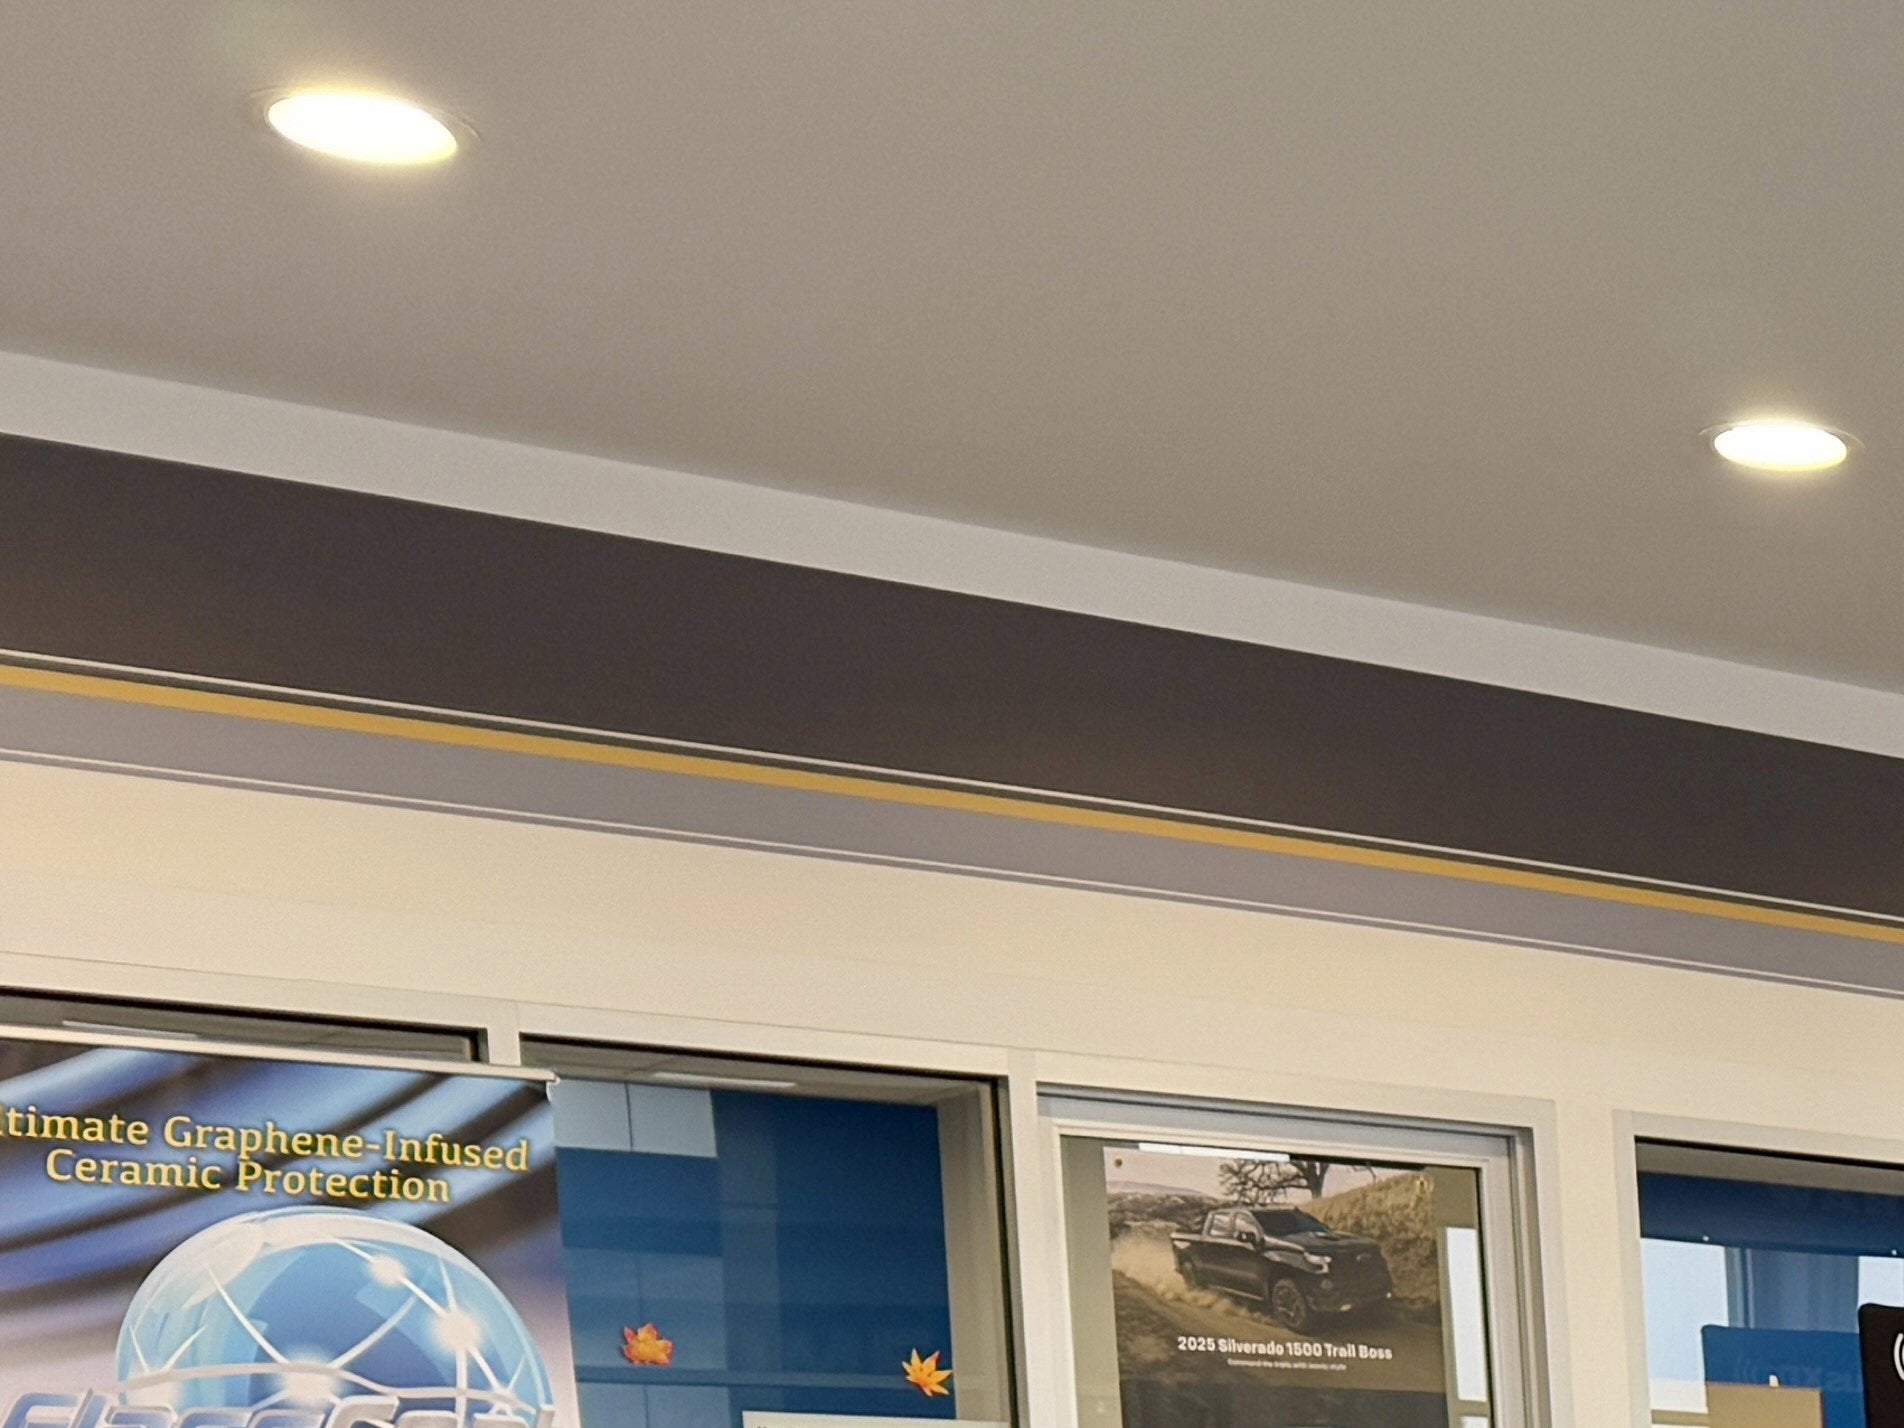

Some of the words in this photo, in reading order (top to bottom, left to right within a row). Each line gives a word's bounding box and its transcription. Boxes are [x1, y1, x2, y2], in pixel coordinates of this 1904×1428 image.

[164, 1115, 531, 1172] Graphene-Infused
[46, 1148, 222, 1190] Ceramic
[237, 1161, 452, 1202] Protection
[1177, 1336, 1216, 1351] 2025
[1217, 1338, 1285, 1356] Silverado
[1286, 1341, 1323, 1357] 1500
[1323, 1343, 1356, 1358] Trail
[1358, 1344, 1393, 1360] Boss
